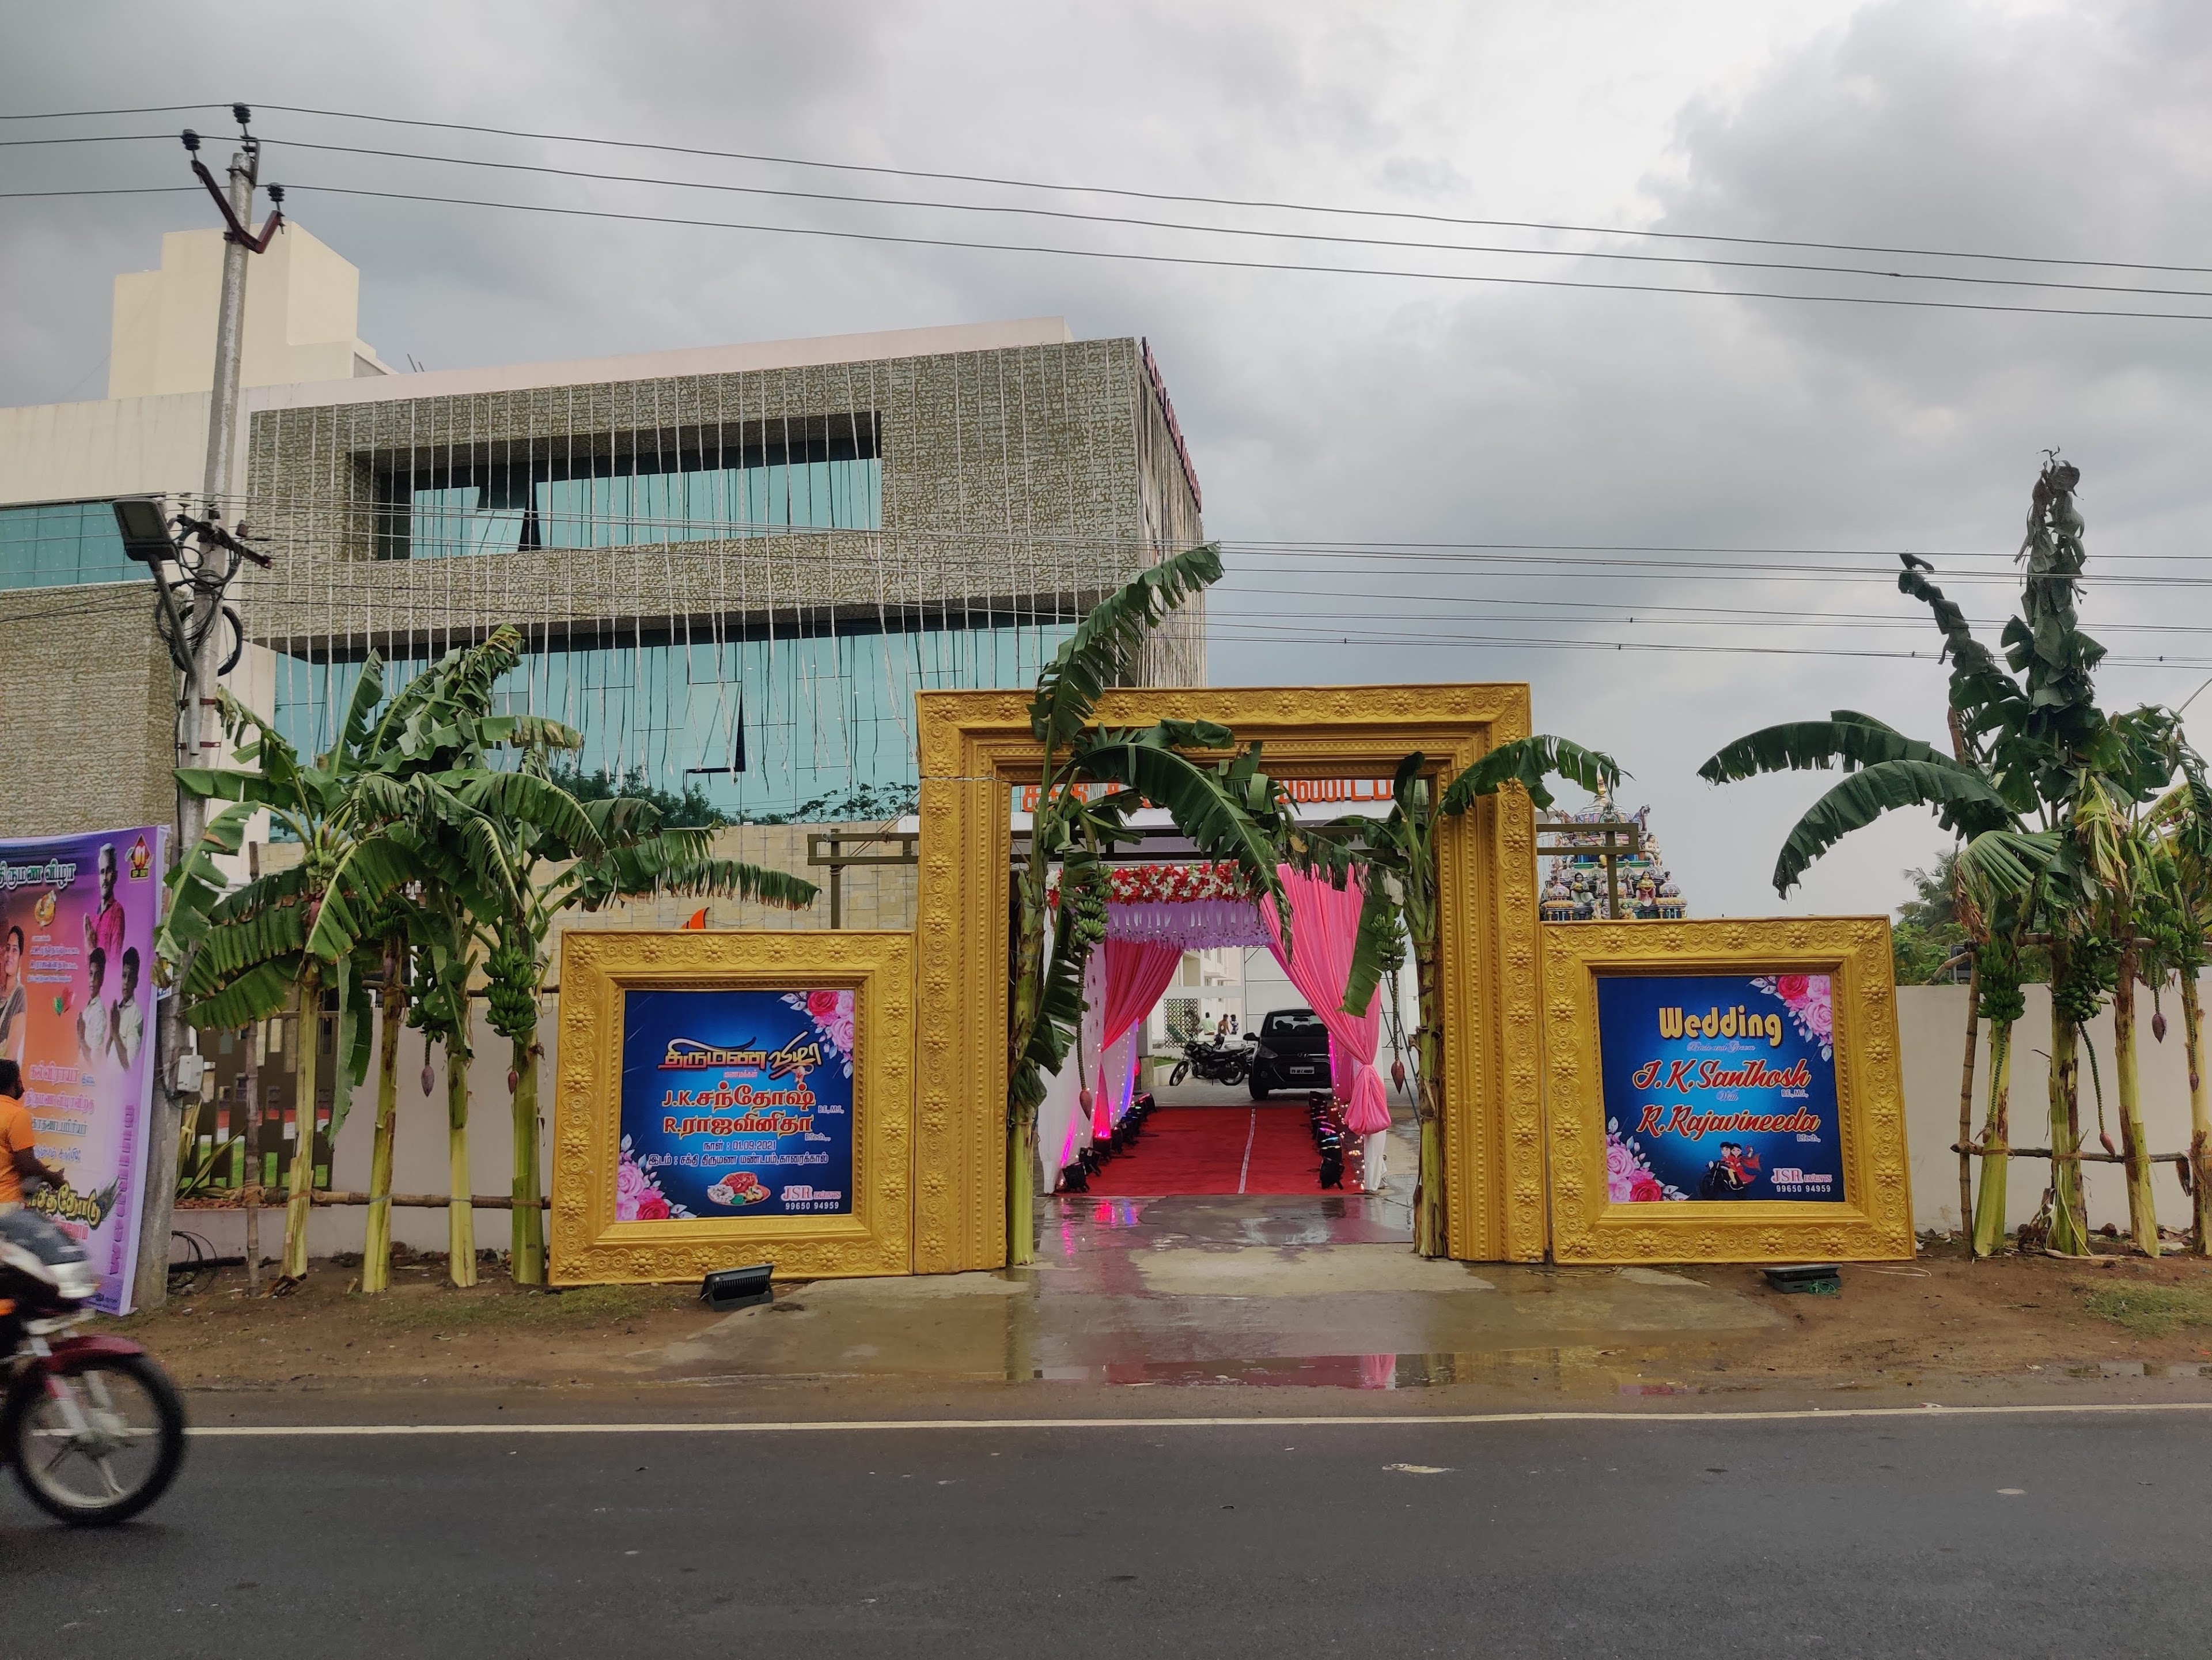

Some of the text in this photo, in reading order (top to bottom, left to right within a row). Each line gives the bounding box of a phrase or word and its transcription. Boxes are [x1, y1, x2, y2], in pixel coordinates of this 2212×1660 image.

[44, 858, 77, 889] விழா
[1659, 1005, 1782, 1047] Wedding
[657, 1035, 767, 1071] திருமண
[703, 1140, 724, 1151] நாள்
[732, 1140, 777, 1151] 01.09.2021
[649, 1153, 672, 1166] இடம்
[680, 1152, 699, 1167] சக்தி
[701, 1154, 737, 1167] திருமண
[1771, 1168, 1804, 1183] JSR
[781, 1185, 813, 1201] JSR
